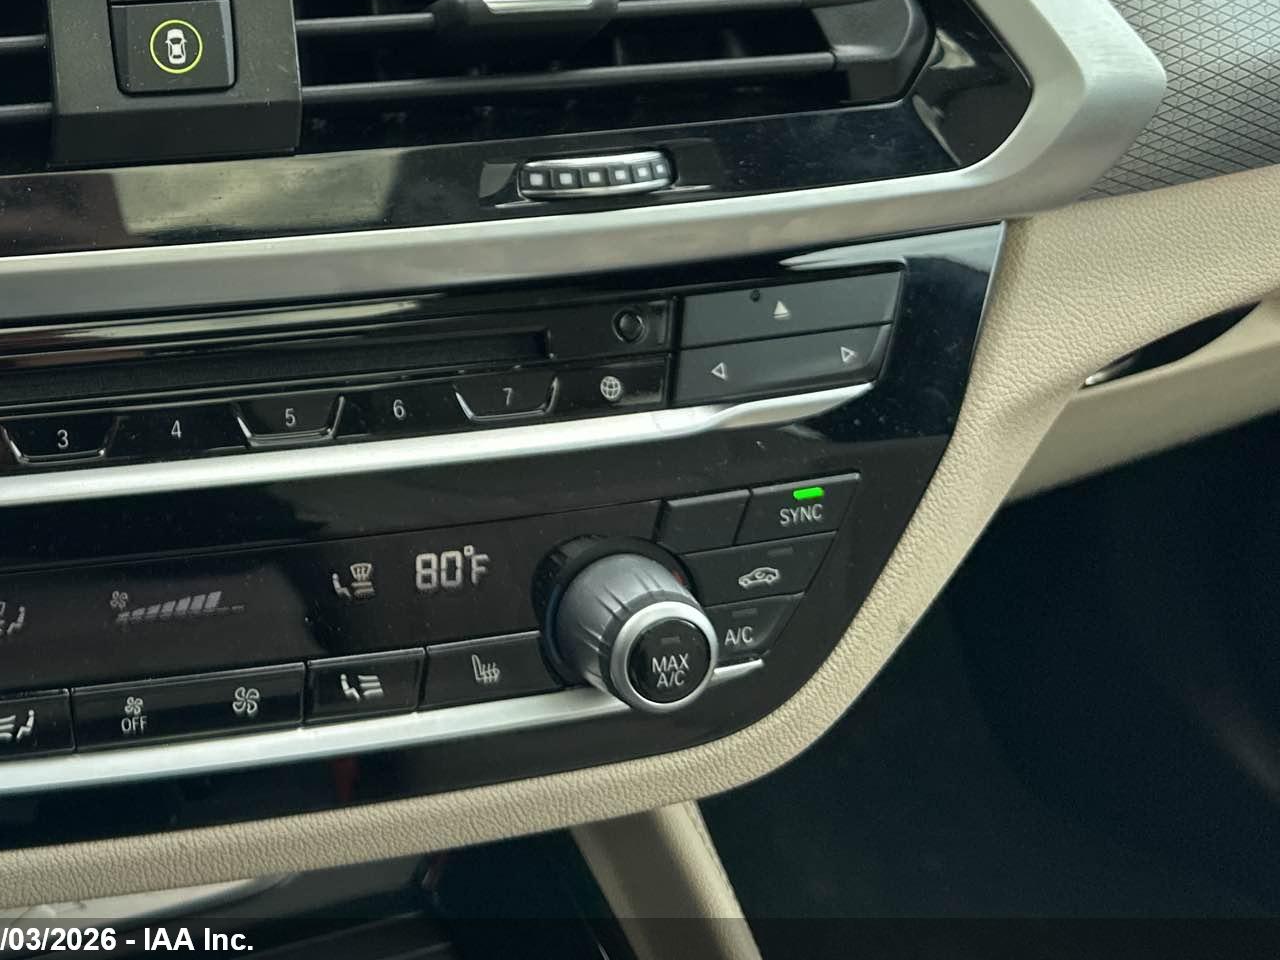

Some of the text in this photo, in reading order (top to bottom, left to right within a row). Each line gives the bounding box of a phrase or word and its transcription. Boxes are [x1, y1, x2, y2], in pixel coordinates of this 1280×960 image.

[502, 387, 513, 406] 7
[285, 408, 296, 428] 5
[393, 399, 406, 418] 6
[57, 429, 69, 448] 3
[171, 420, 182, 439] 4
[779, 504, 823, 526] SYNC
[724, 626, 753, 646] A/C
[652, 653, 689, 674] MAX
[656, 669, 686, 689] A/C
[121, 716, 147, 734] OFF
